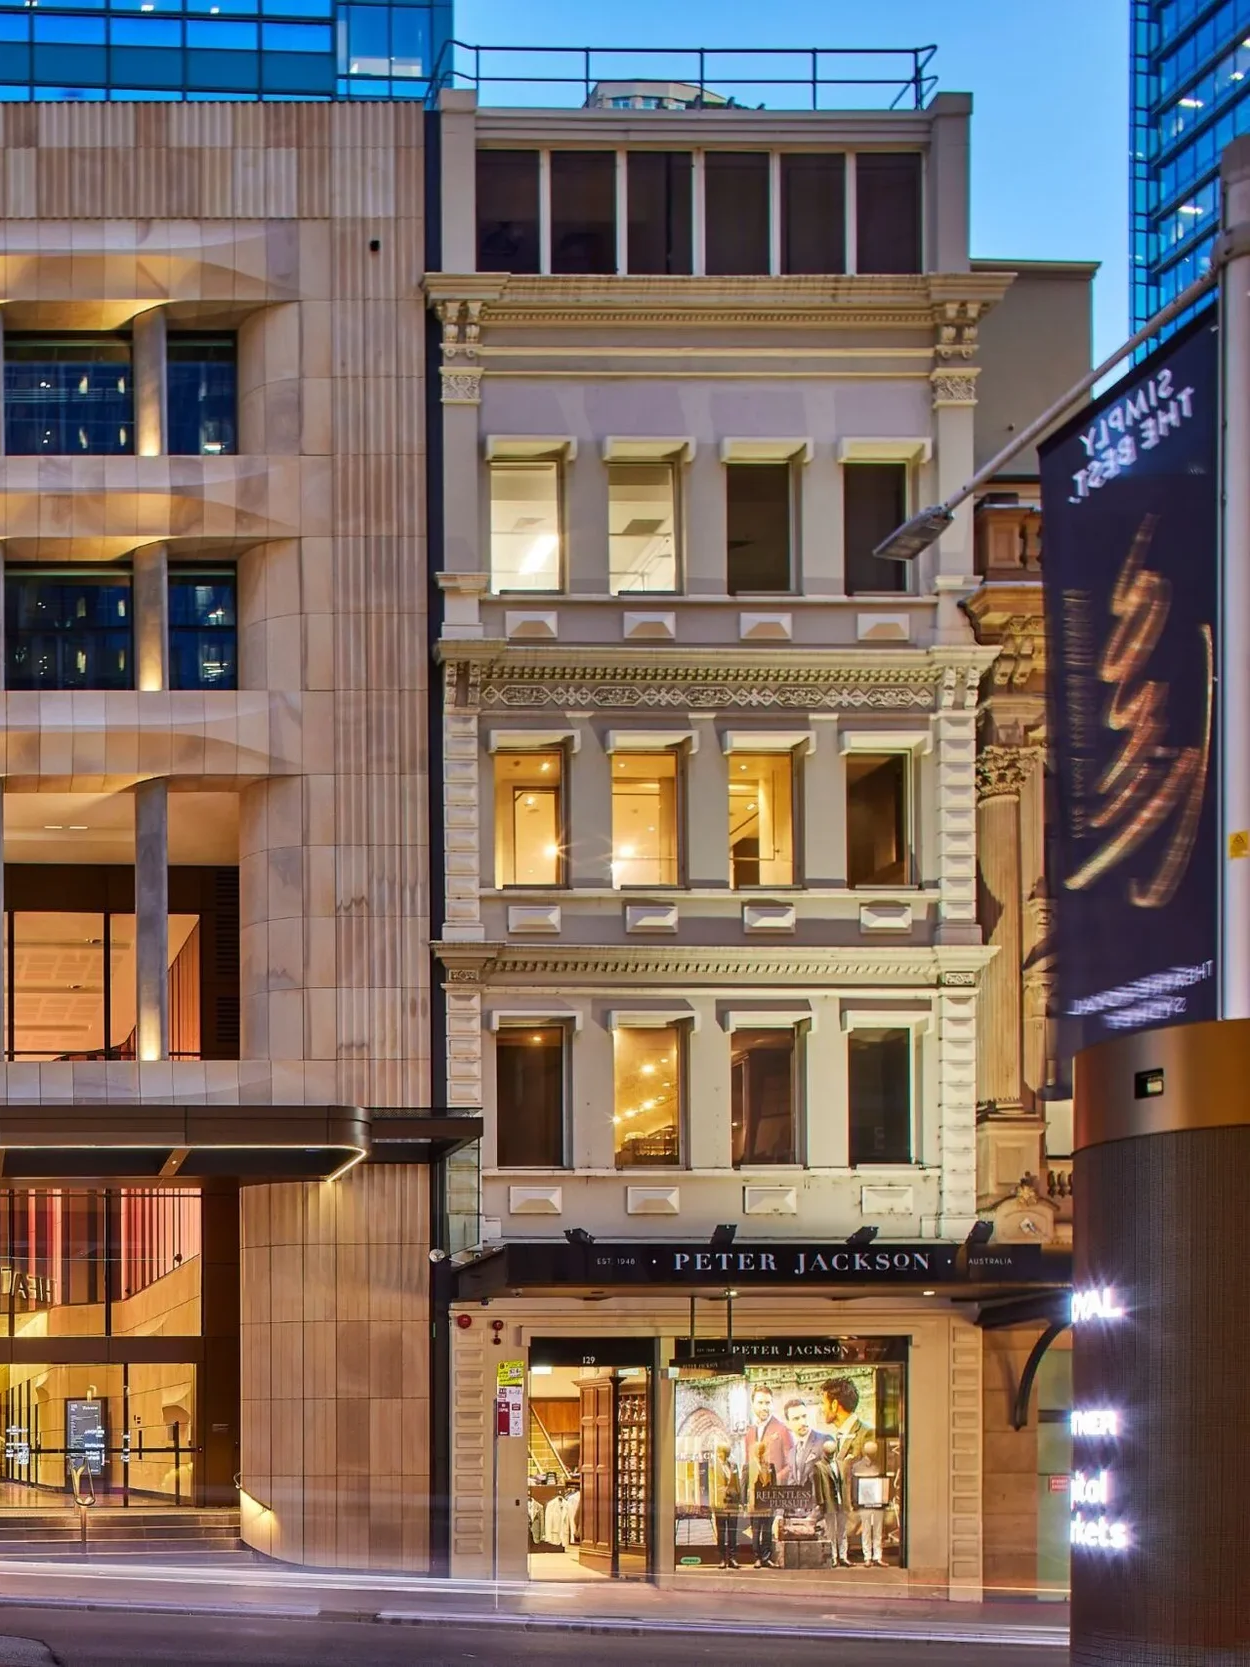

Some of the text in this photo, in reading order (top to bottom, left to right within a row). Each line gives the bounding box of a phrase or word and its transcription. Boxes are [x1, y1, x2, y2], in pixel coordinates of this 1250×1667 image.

[673, 1253, 777, 1271] PETER
[794, 1253, 931, 1275] JACKSON
[968, 1257, 1012, 1265] AUSTRALIA
[732, 1345, 850, 1357] PETER JACKSON
[582, 1356, 596, 1365] 129
[756, 1489, 811, 1502] RELENTLESS
[770, 1499, 808, 1508] PURSUIT
